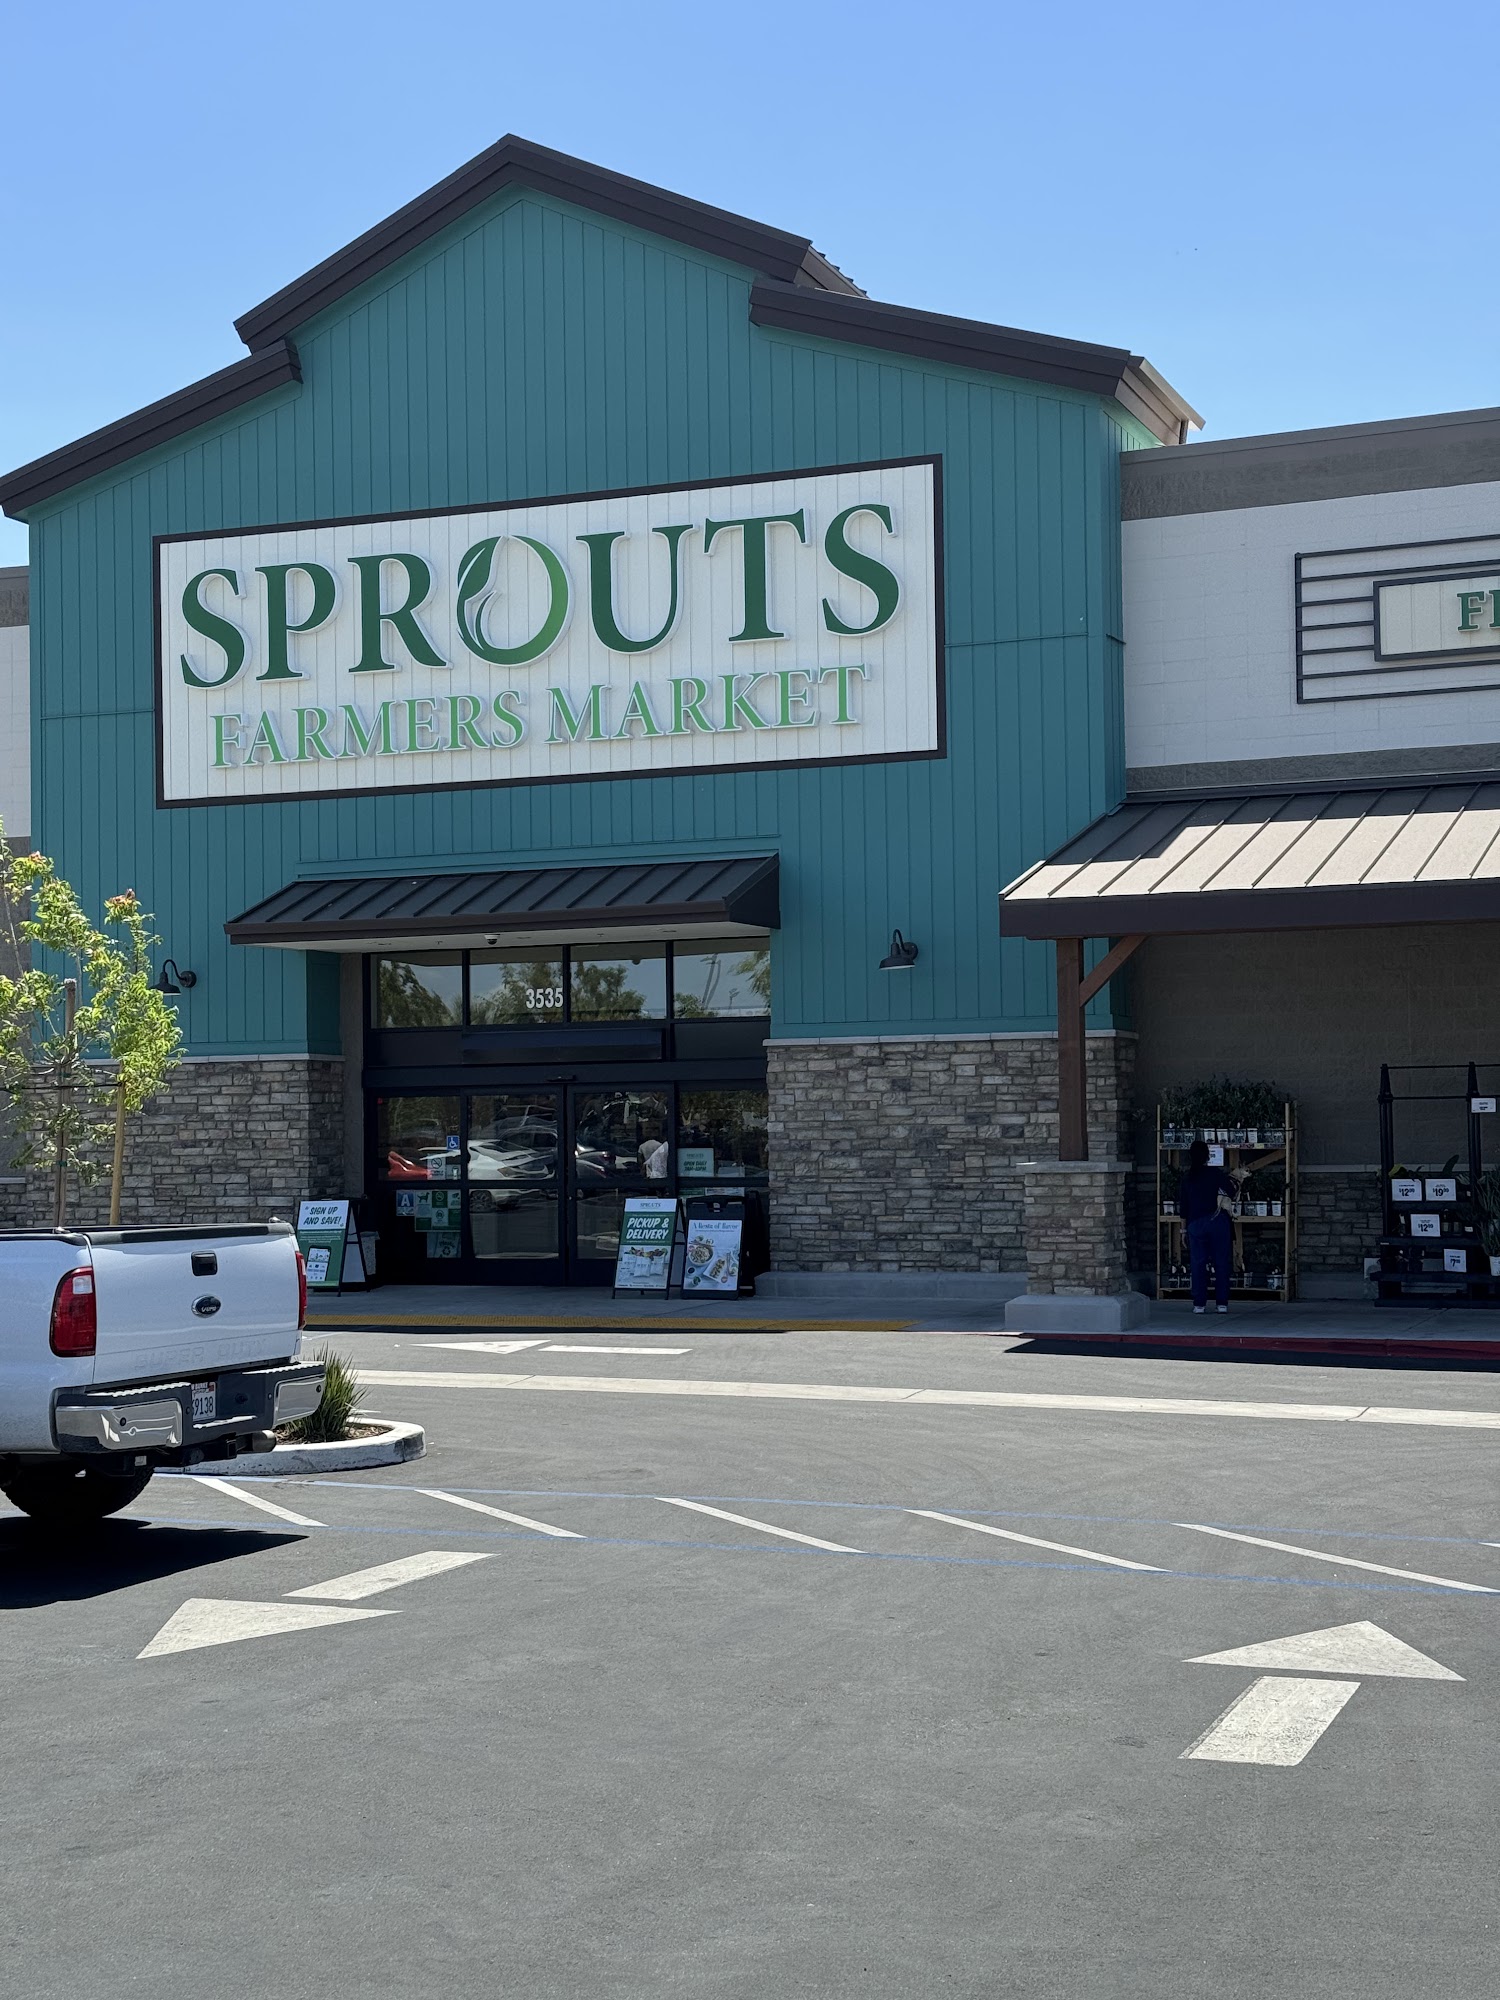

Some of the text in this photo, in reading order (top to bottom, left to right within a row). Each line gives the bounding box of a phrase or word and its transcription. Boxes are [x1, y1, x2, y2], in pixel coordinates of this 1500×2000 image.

[180, 503, 901, 689] SPROUTS
[210, 663, 869, 768] FARMERS MARKET
[526, 988, 564, 1009] 3535
[401, 1194, 410, 1207] A
[309, 1206, 339, 1216] SIGN UP
[303, 1215, 341, 1226] AND SAVE!
[626, 1217, 669, 1229] PICKUP &
[626, 1228, 669, 1240] DELIVERY
